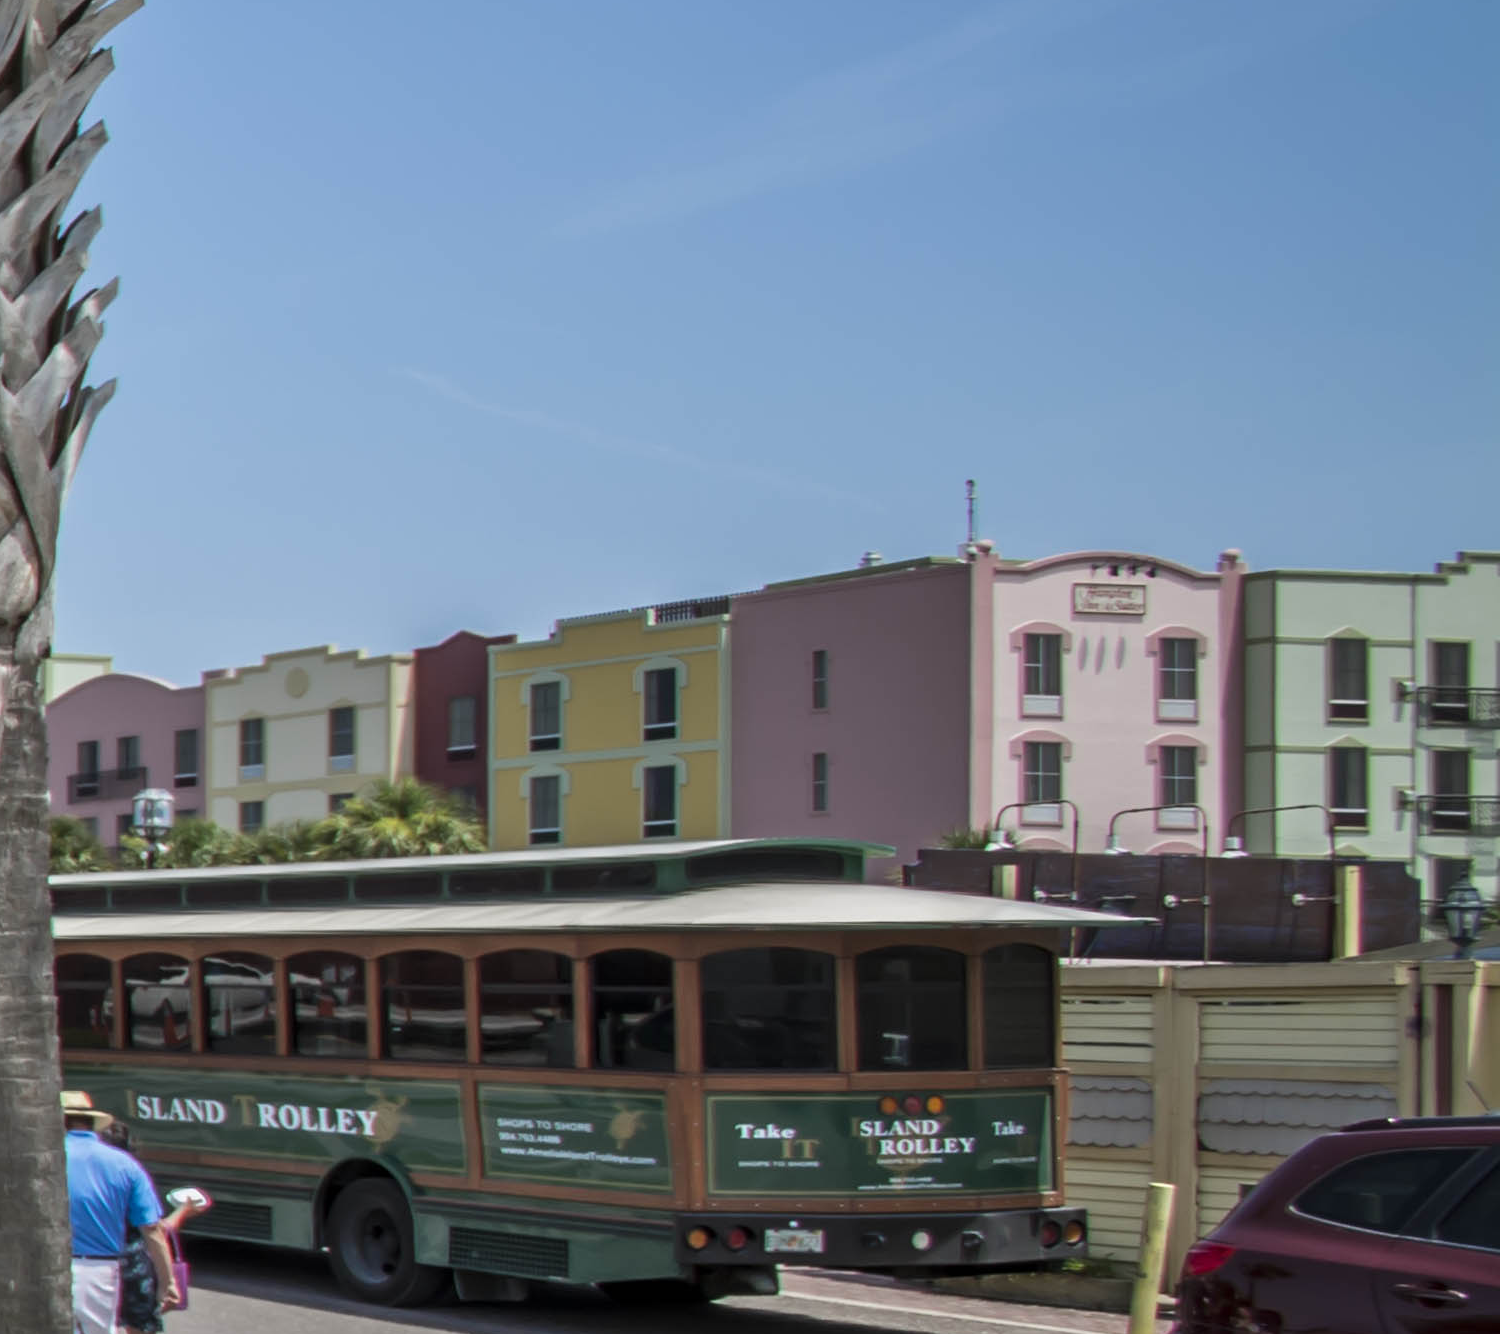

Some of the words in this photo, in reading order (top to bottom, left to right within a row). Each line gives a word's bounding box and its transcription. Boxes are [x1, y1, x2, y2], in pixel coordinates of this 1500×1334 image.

[125, 1089, 227, 1125] ISLAND
[232, 1094, 378, 1137] TROLLEY
[536, 1120, 551, 1130] TO
[734, 1123, 797, 1139] Take
[991, 1121, 1026, 1136] Take
